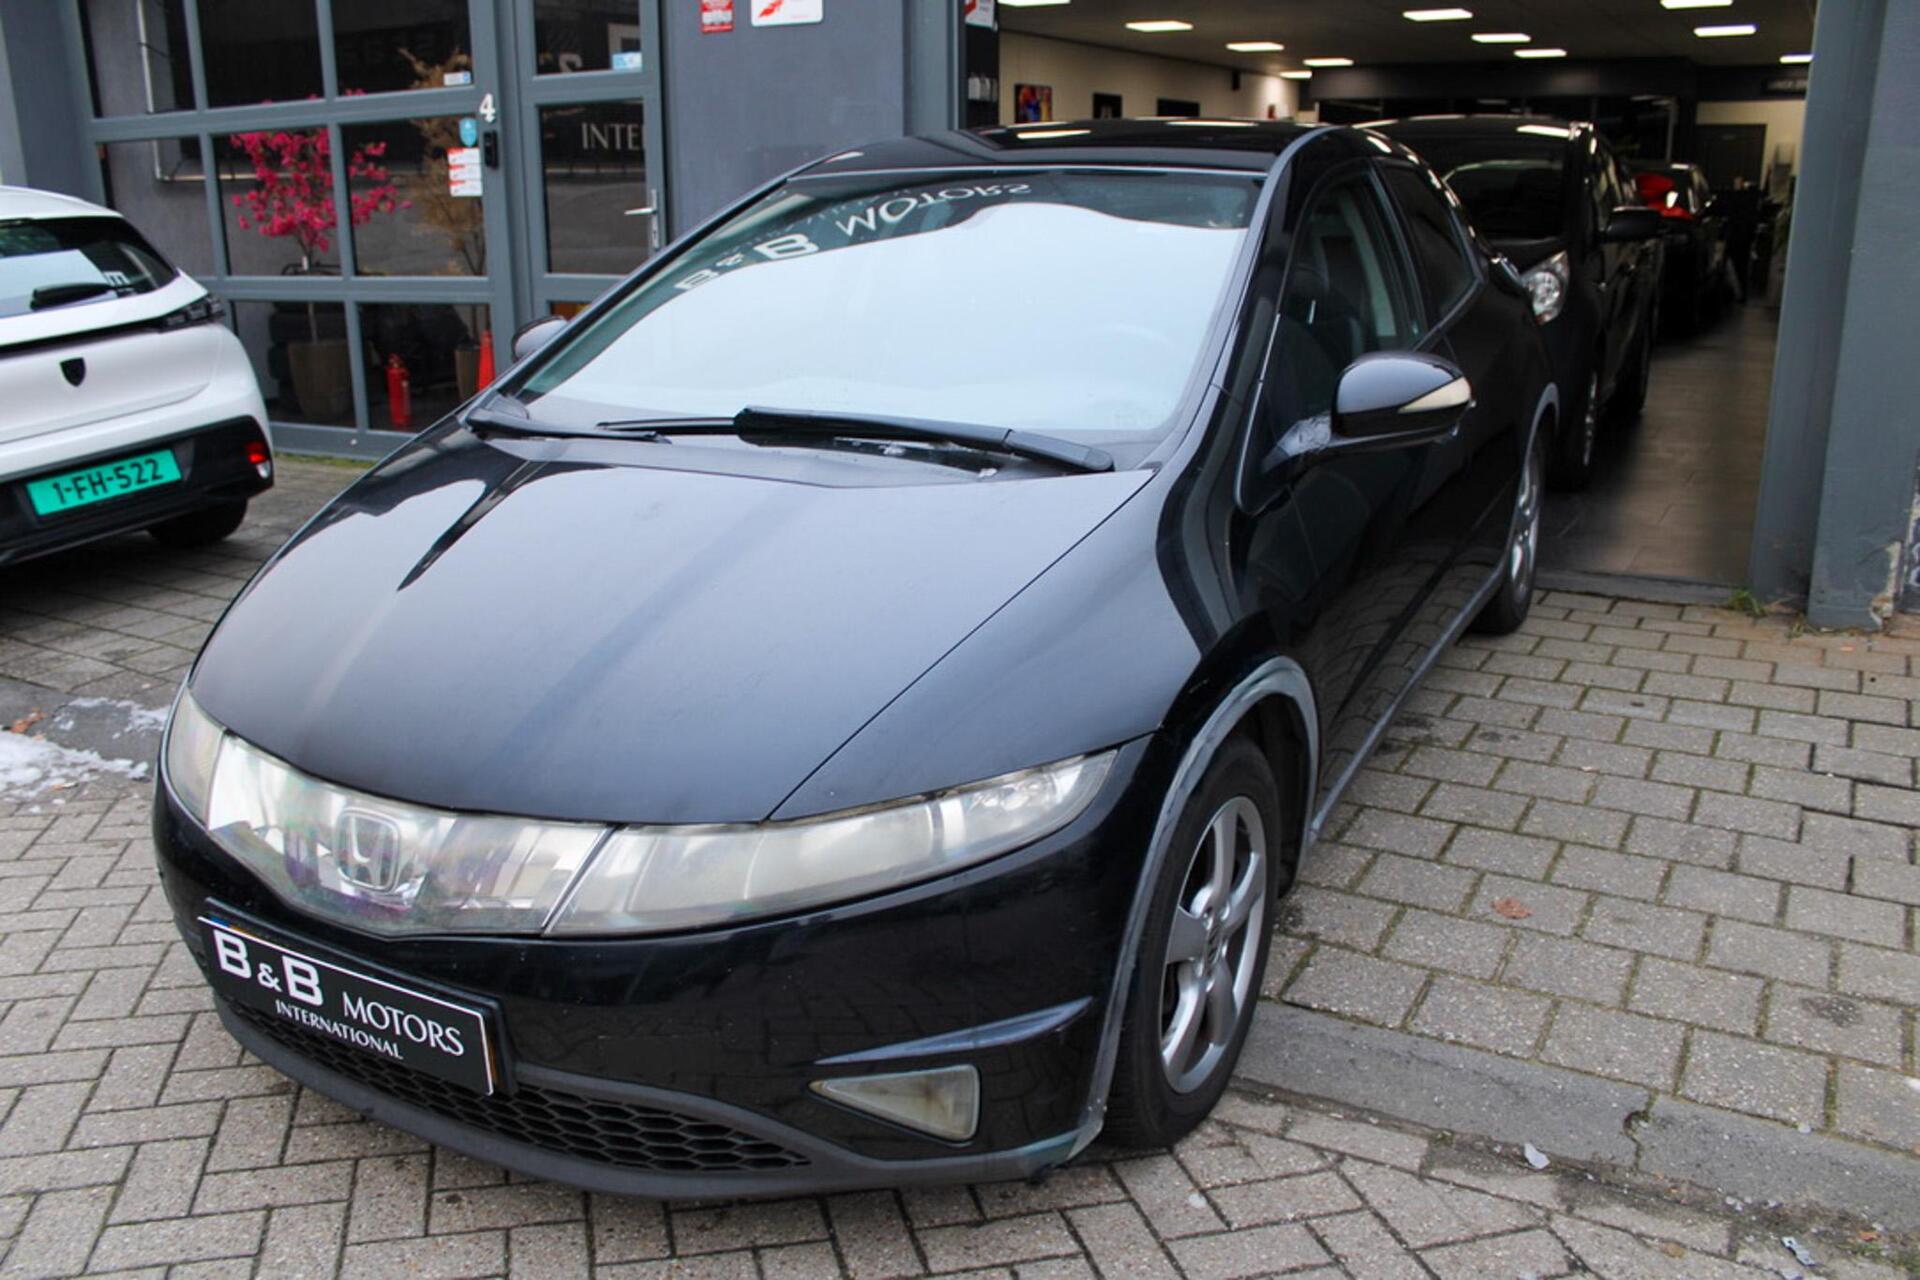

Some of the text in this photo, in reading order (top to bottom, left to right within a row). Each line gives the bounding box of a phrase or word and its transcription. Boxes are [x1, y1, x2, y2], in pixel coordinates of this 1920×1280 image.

[480, 93, 496, 123] 4
[581, 122, 646, 151] INTE
[52, 458, 163, 504] 1-FH-522
[275, 1000, 403, 1060] INTERNATIONAL
[342, 991, 464, 1056] MOTORS
